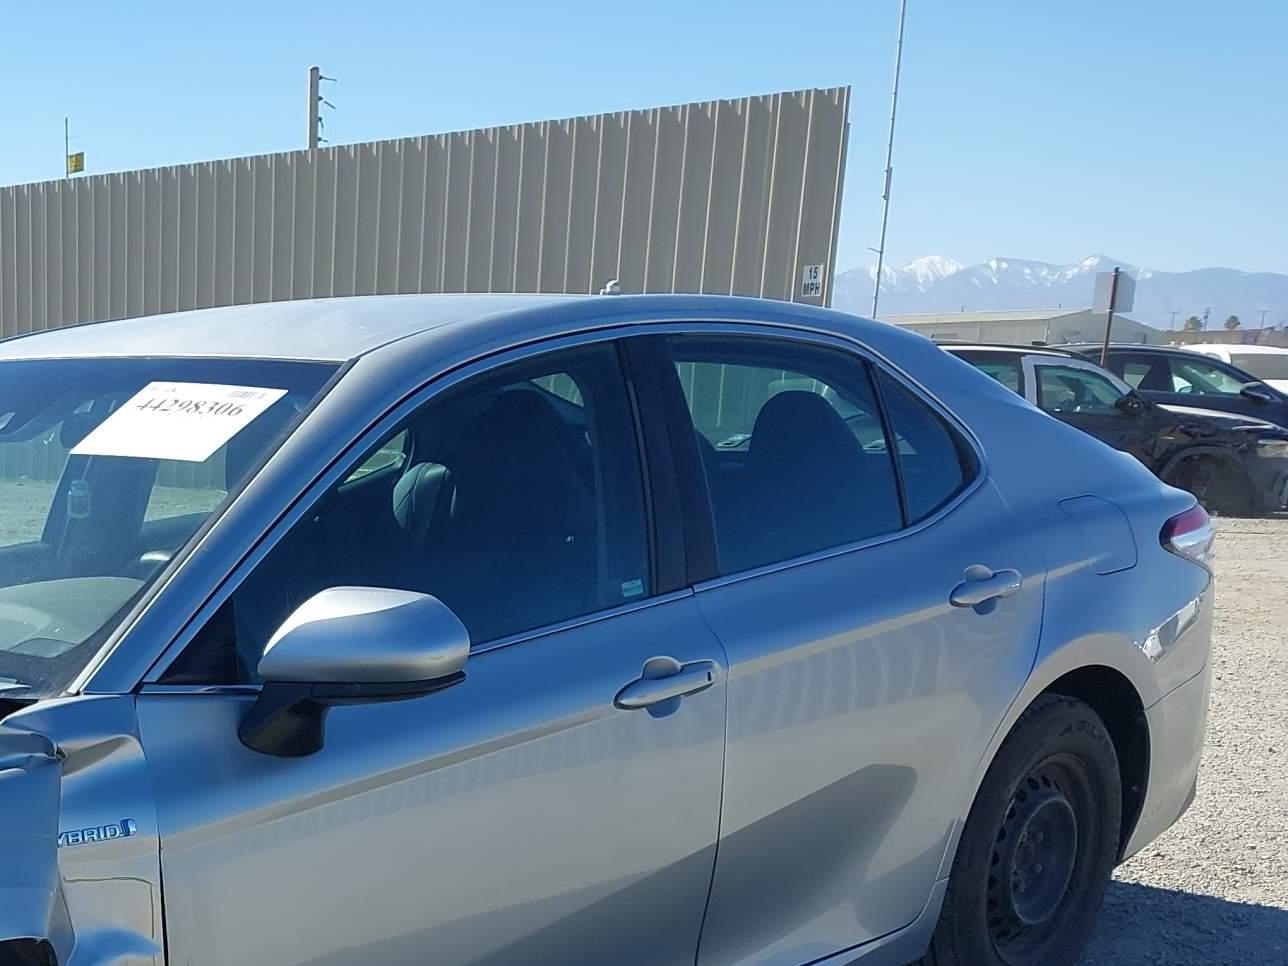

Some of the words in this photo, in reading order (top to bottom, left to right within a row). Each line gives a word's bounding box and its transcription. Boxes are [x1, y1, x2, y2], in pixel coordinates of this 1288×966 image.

[809, 266, 818, 279] 15
[803, 282, 820, 295] MPH
[136, 398, 247, 417] 44298306
